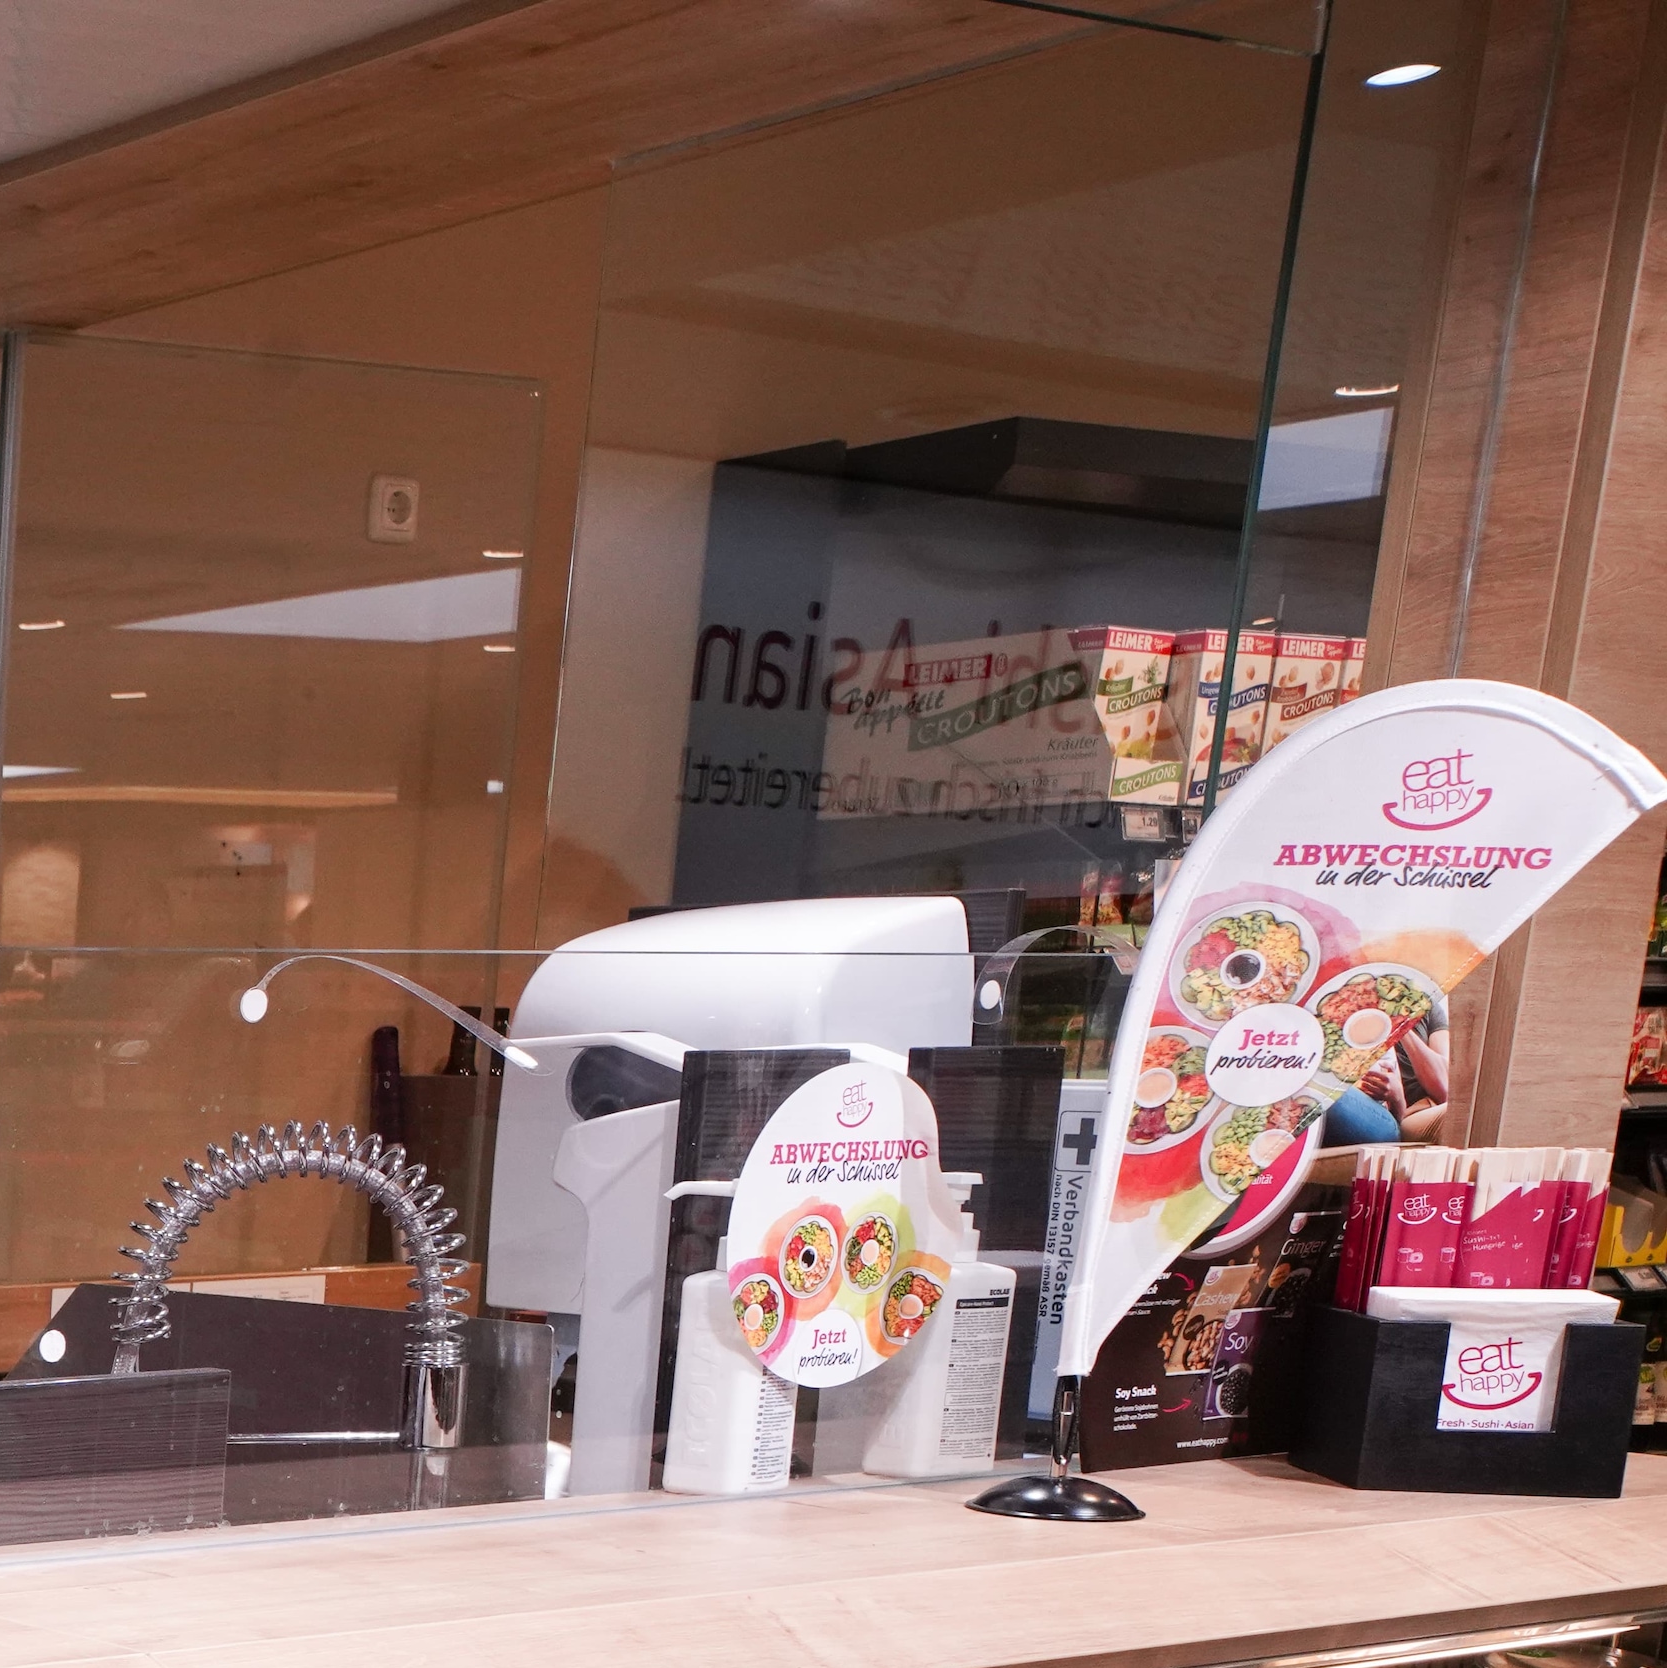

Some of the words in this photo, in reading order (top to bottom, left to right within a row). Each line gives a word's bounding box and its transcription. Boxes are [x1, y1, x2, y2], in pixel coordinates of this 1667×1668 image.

[1109, 631, 1153, 651] LEIMER
[1208, 633, 1255, 652] LEIER
[1282, 639, 1325, 658] LEIMER
[917, 668, 1079, 748] CROUTONS
[1109, 686, 1163, 712] CROUTONS
[1283, 692, 1336, 718] CROUTONS
[1119, 764, 1177, 793] CROUTONS
[1402, 749, 1474, 793] eat
[1402, 786, 1474, 814] happy
[1273, 844, 1553, 869] ABWECHSLUNG
[1316, 863, 1336, 885] in
[1344, 862, 1392, 887] der
[1393, 862, 1501, 889] Schüssel
[1239, 1028, 1301, 1051] Jetzt
[1209, 1048, 1317, 1075] probieren!
[842, 1080, 868, 1107] eat
[842, 1100, 869, 1119] happy
[770, 1139, 929, 1166] ABWECHSLUNG
[787, 1161, 804, 1184] in
[806, 1159, 835, 1184] der
[837, 1155, 903, 1184] Schüssel
[1054, 1173, 1063, 1199] nach
[1050, 1202, 1060, 1221] DIN
[1404, 1193, 1430, 1209] eat
[1047, 1225, 1058, 1255] 13157
[1049, 1174, 1084, 1325] Verbandkasten
[1281, 1238, 1326, 1258] Ginger
[990, 1288, 1010, 1296] ECOLAB
[1039, 1296, 1048, 1318] ASR
[812, 1328, 847, 1349] Jetzt
[1225, 1331, 1254, 1353] Soy
[797, 1346, 859, 1374] probieren!
[1459, 1337, 1524, 1376] eat
[1115, 1387, 1130, 1401] Soy
[1131, 1384, 1158, 1398] Snack
[1459, 1369, 1525, 1396] happy
[1437, 1418, 1465, 1428] Fresh
[1471, 1419, 1500, 1429] Sushi
[1504, 1420, 1535, 1430] Asian
[1177, 1436, 1228, 1449] www.eathappy.com
